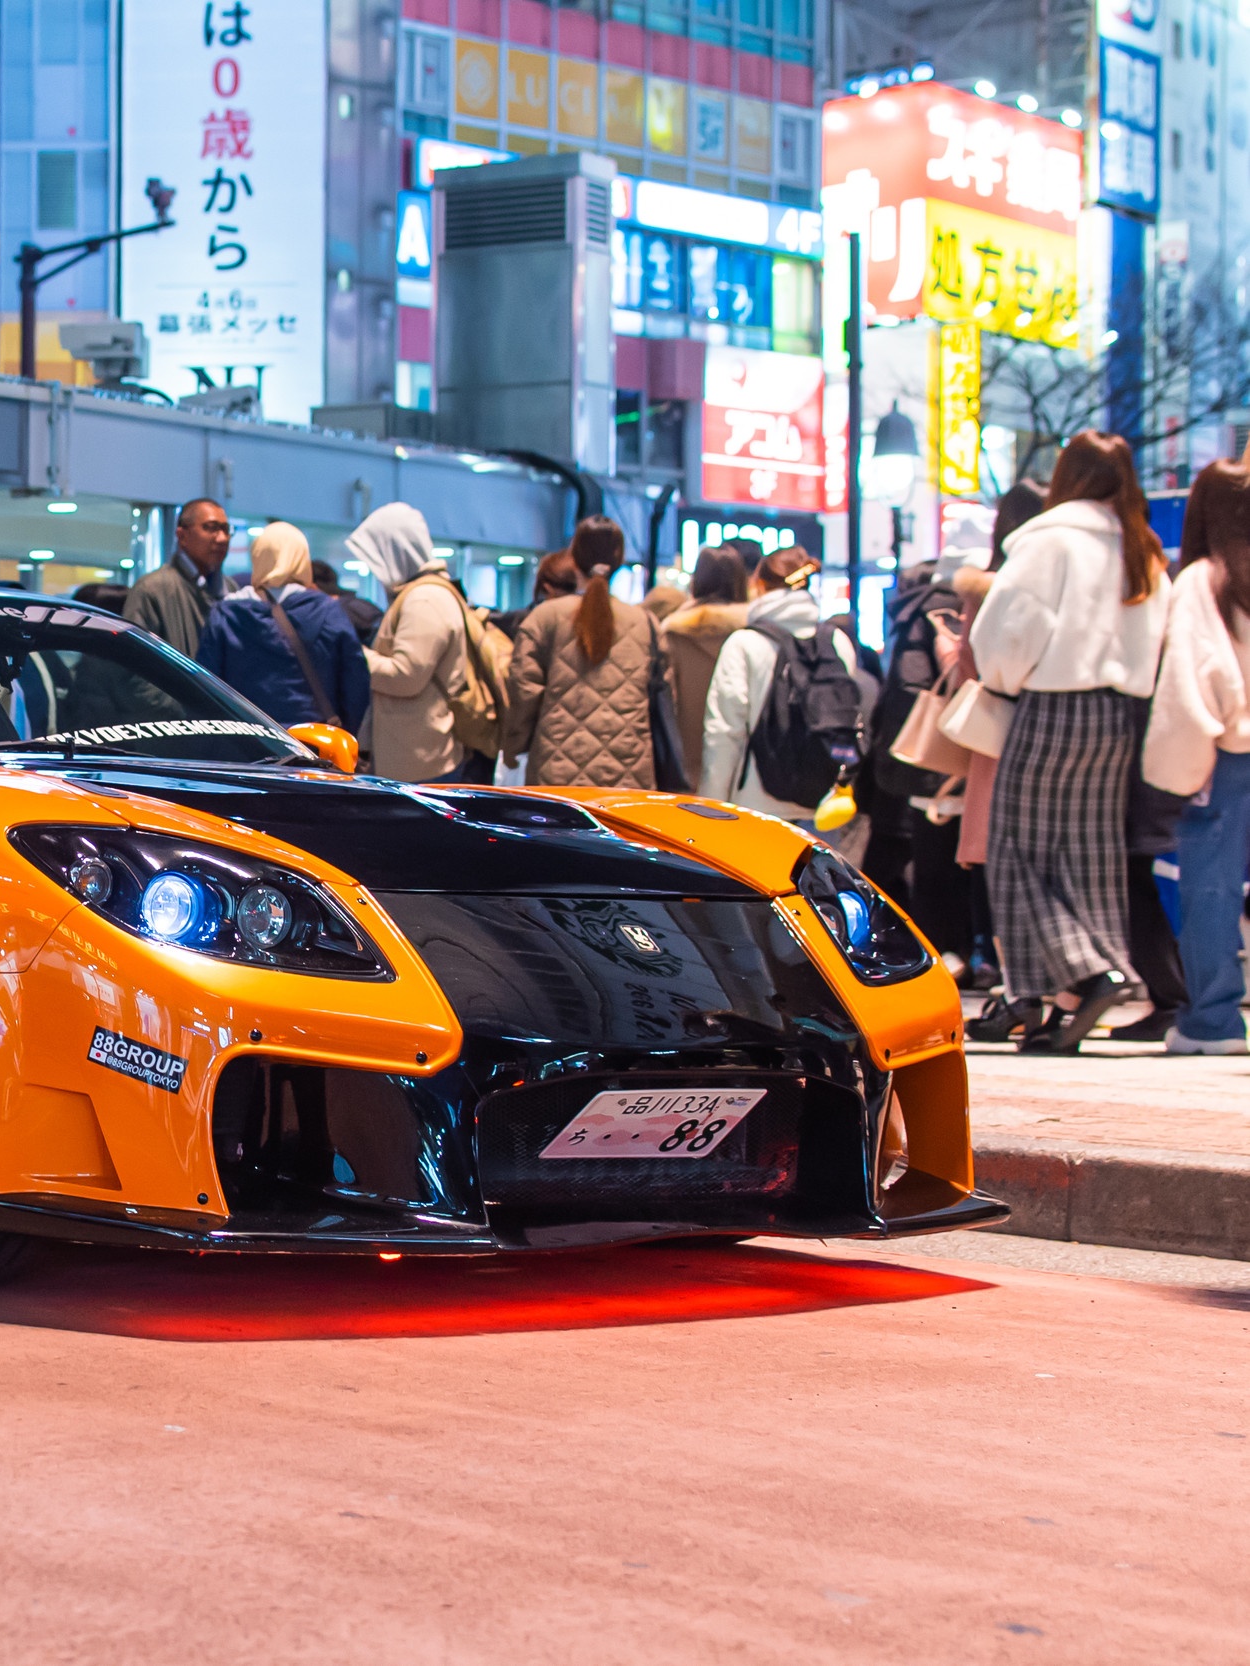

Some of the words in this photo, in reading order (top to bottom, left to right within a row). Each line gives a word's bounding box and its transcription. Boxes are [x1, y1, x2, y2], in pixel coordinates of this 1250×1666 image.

[724, 409, 803, 461] アコム
[93, 1032, 184, 1077] 88GROUP
[106, 1055, 179, 1089] @88GROUPTOKYO
